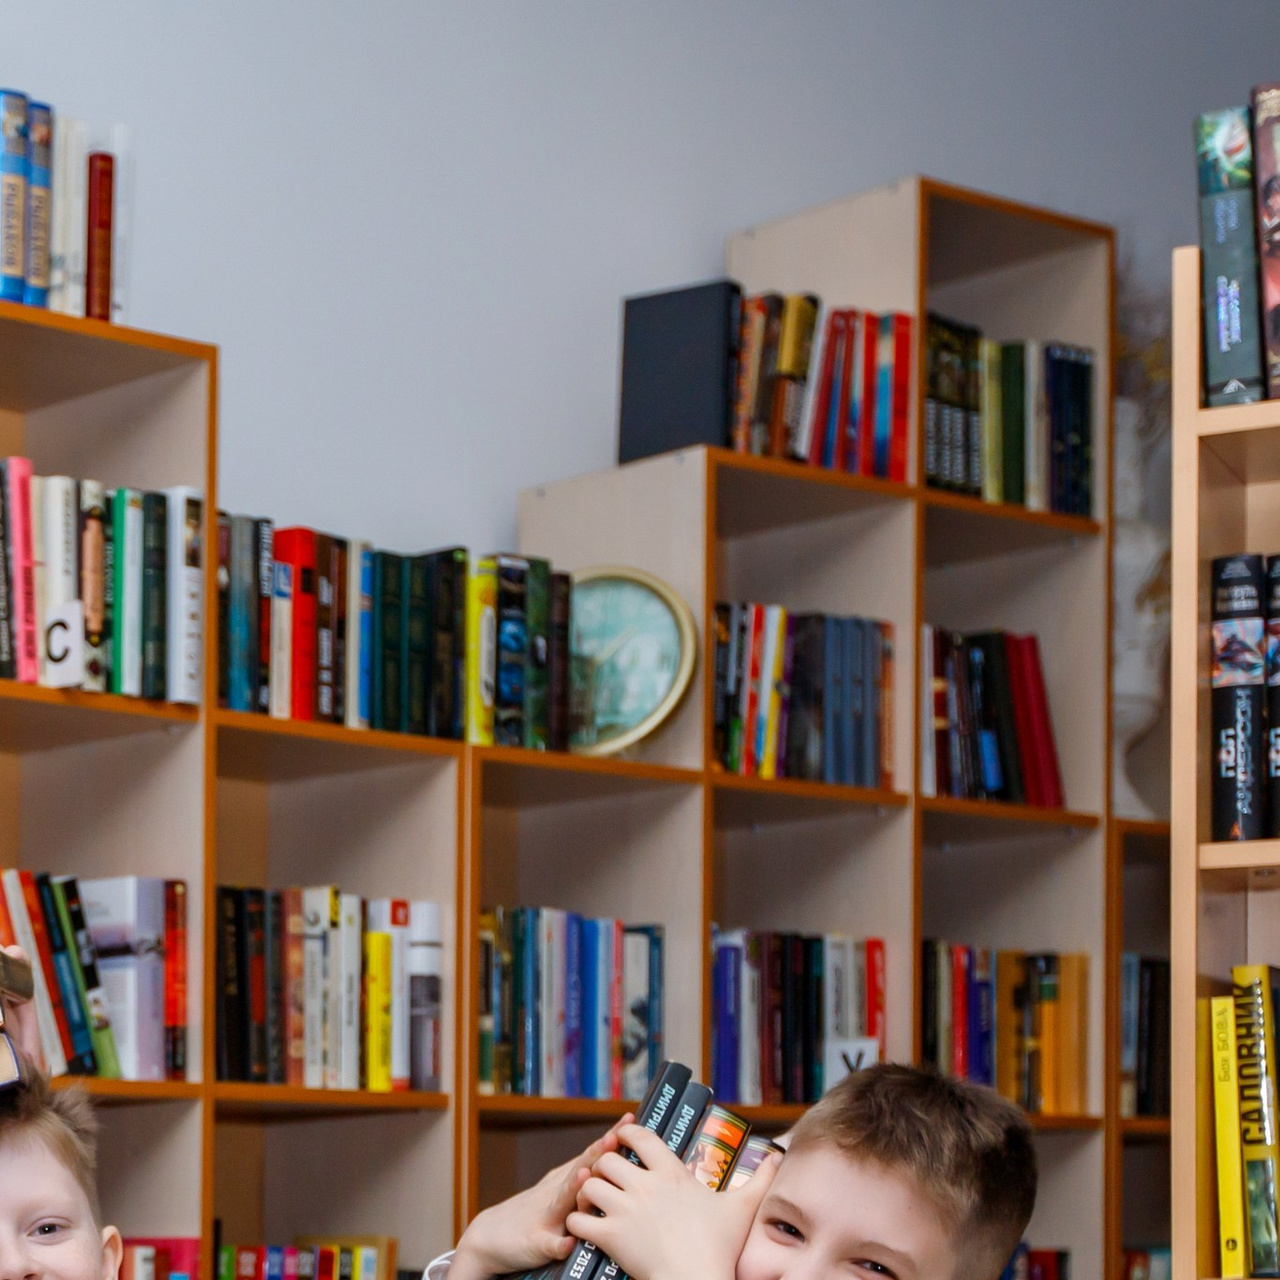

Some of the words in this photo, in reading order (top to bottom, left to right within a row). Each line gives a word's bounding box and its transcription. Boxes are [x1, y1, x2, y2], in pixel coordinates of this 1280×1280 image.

[46, 619, 69, 663] С
[1216, 1006, 1229, 1053] БОВА
[1233, 977, 1266, 1146] САДОВНИК
[643, 1082, 676, 1134] ДМИТРИ
[666, 1104, 696, 1153] ДМИТРИ
[569, 1251, 592, 1280] 2033
